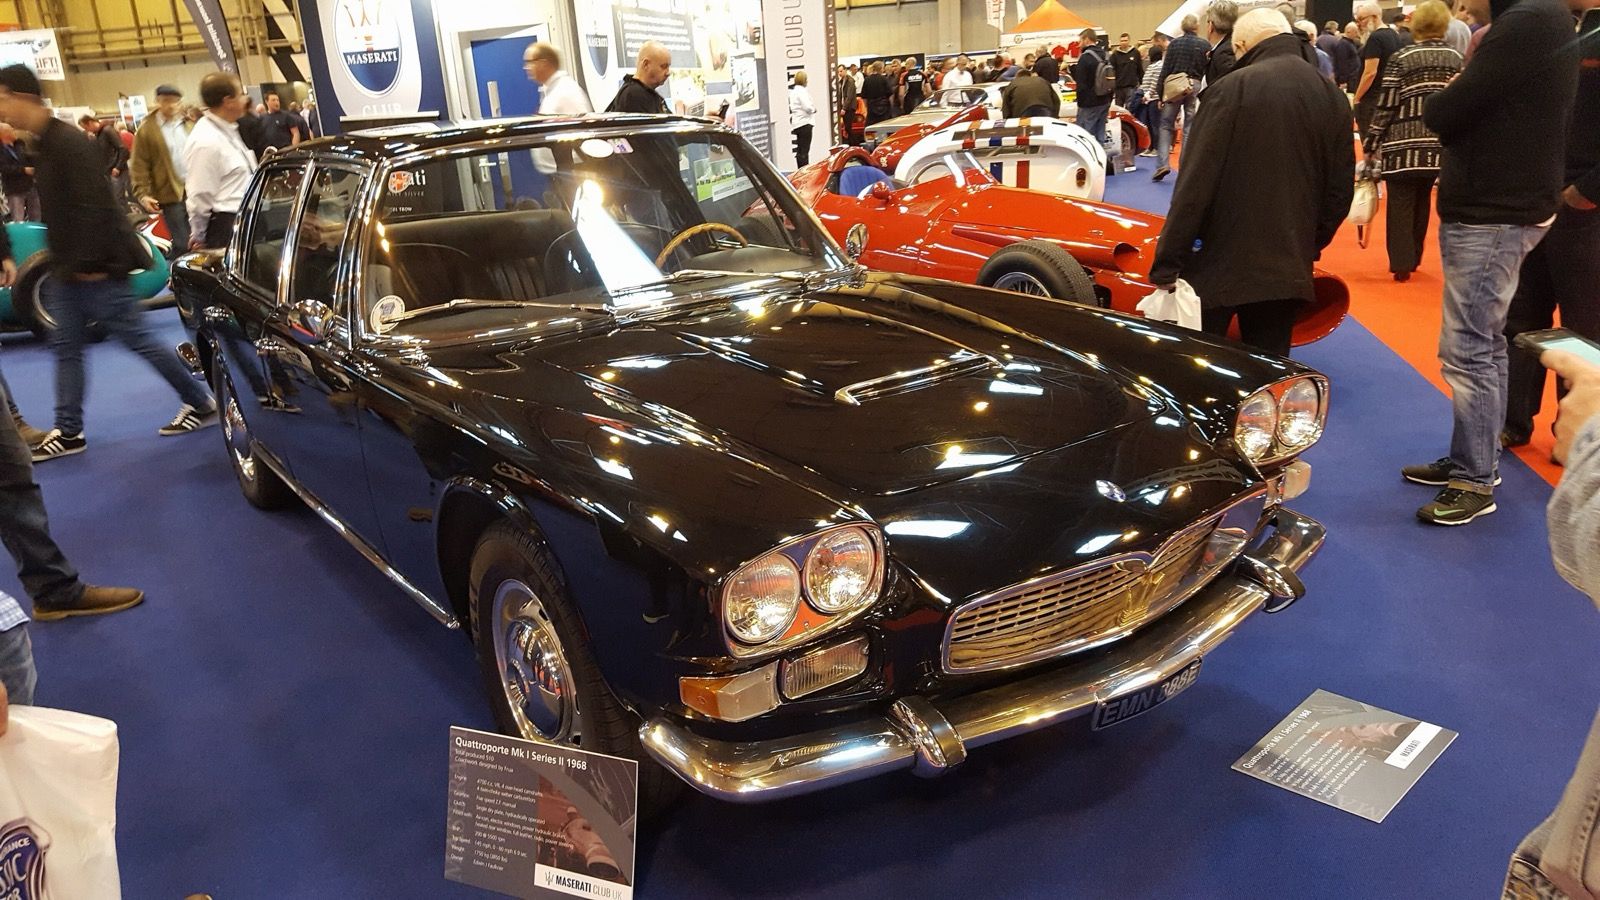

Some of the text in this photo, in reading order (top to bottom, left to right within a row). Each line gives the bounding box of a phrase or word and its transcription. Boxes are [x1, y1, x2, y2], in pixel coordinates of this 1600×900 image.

[784, 15, 805, 59] CLUB
[346, 50, 398, 66] MASERATI
[1101, 687, 1155, 726] EMN
[455, 736, 587, 770] Quattroporte Mk I Series II 1968
[555, 875, 623, 900] MASERATI CLUB UK
